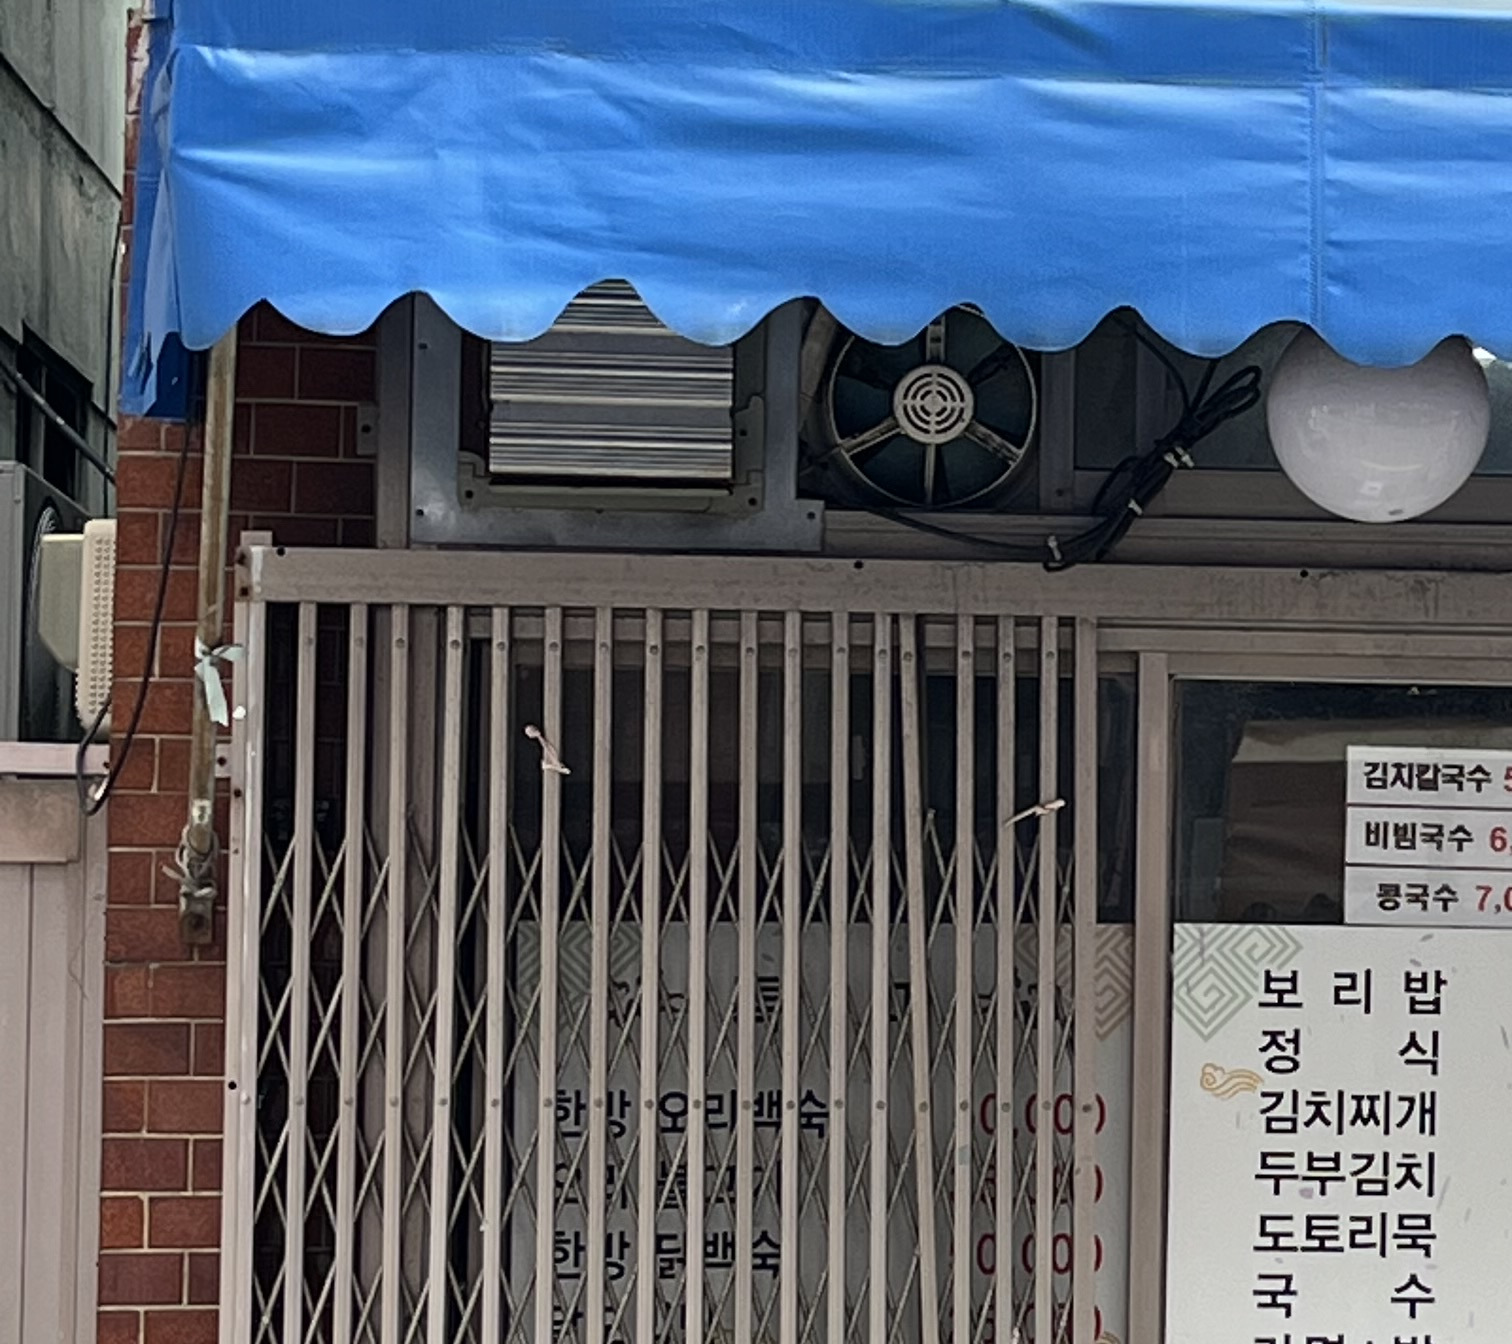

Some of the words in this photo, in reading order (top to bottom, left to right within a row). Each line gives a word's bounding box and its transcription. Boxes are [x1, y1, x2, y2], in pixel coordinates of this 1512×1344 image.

[1365, 820, 1473, 853] 비빔국수
[1376, 883, 1459, 912] 콩국수
[1259, 1089, 1438, 1136] 김치찌개
[1254, 1151, 1437, 1198] 두부김치
[1252, 1211, 1437, 1258] 도토리묵
